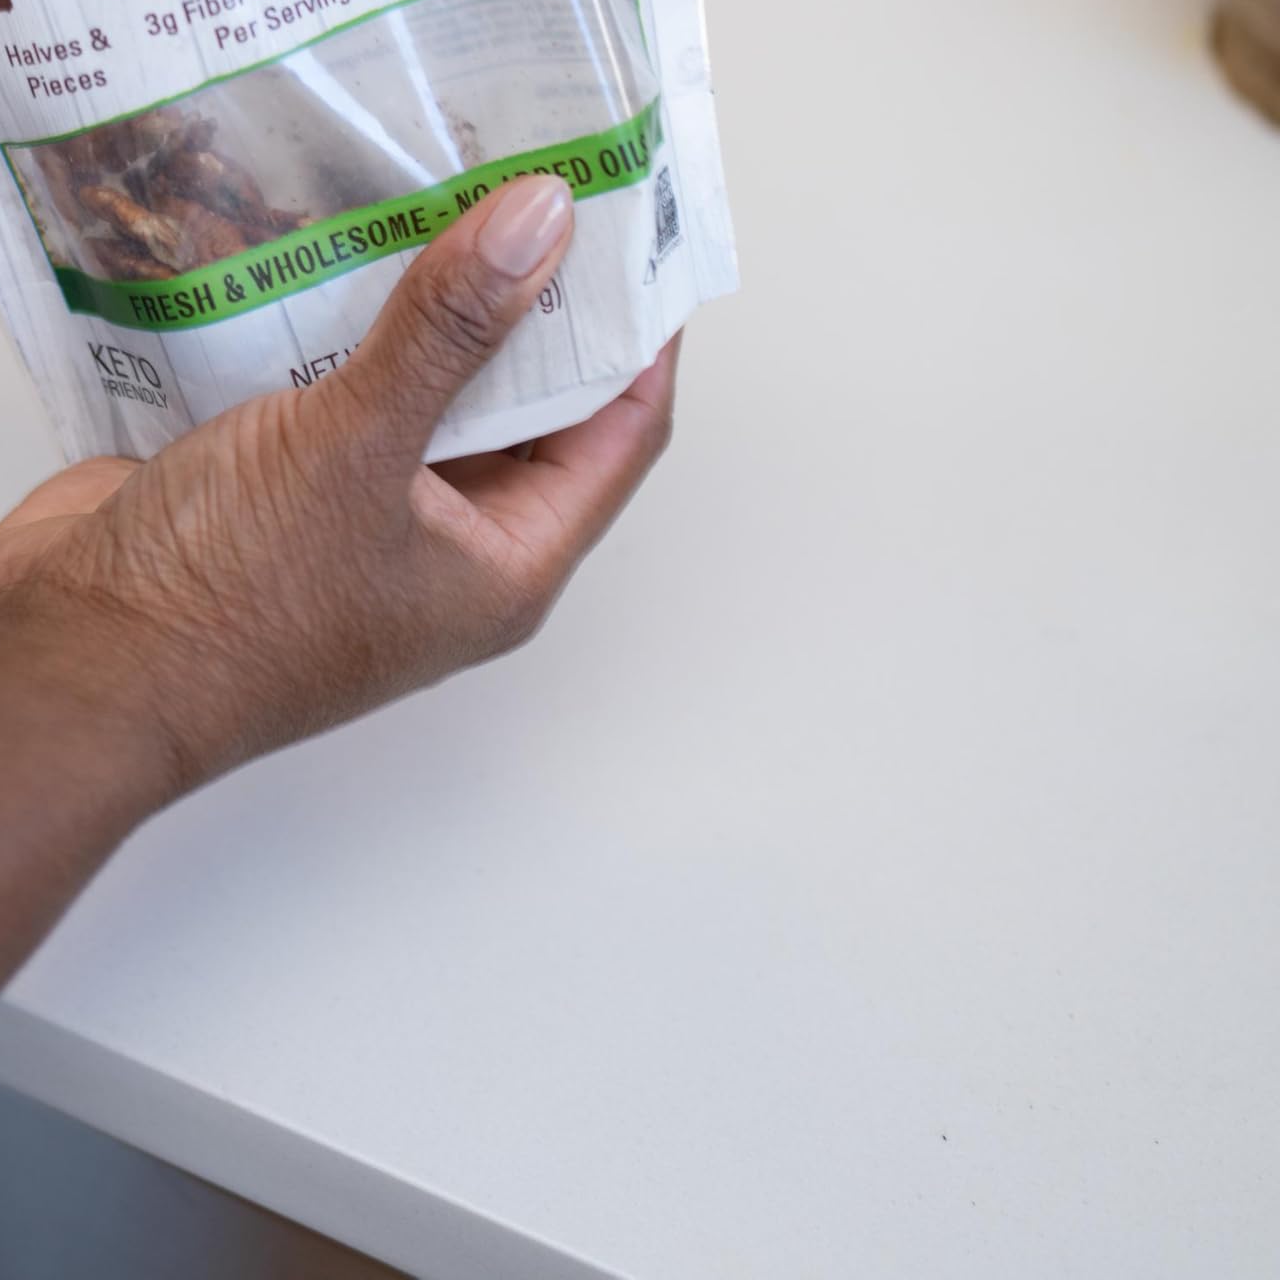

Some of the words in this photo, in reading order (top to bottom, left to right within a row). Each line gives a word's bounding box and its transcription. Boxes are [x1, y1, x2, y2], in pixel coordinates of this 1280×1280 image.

[145, 14, 178, 38] 3g
[214, 20, 259, 50] Per
[5, 36, 82, 67] Halves
[89, 27, 111, 52] &
[27, 70, 108, 99] Pieces
[129, 283, 217, 322] FRESH
[223, 273, 246, 302] &
[246, 207, 431, 293] WHOLESOME
[87, 341, 162, 390] KETO
[101, 377, 168, 410] FRIENDLY
